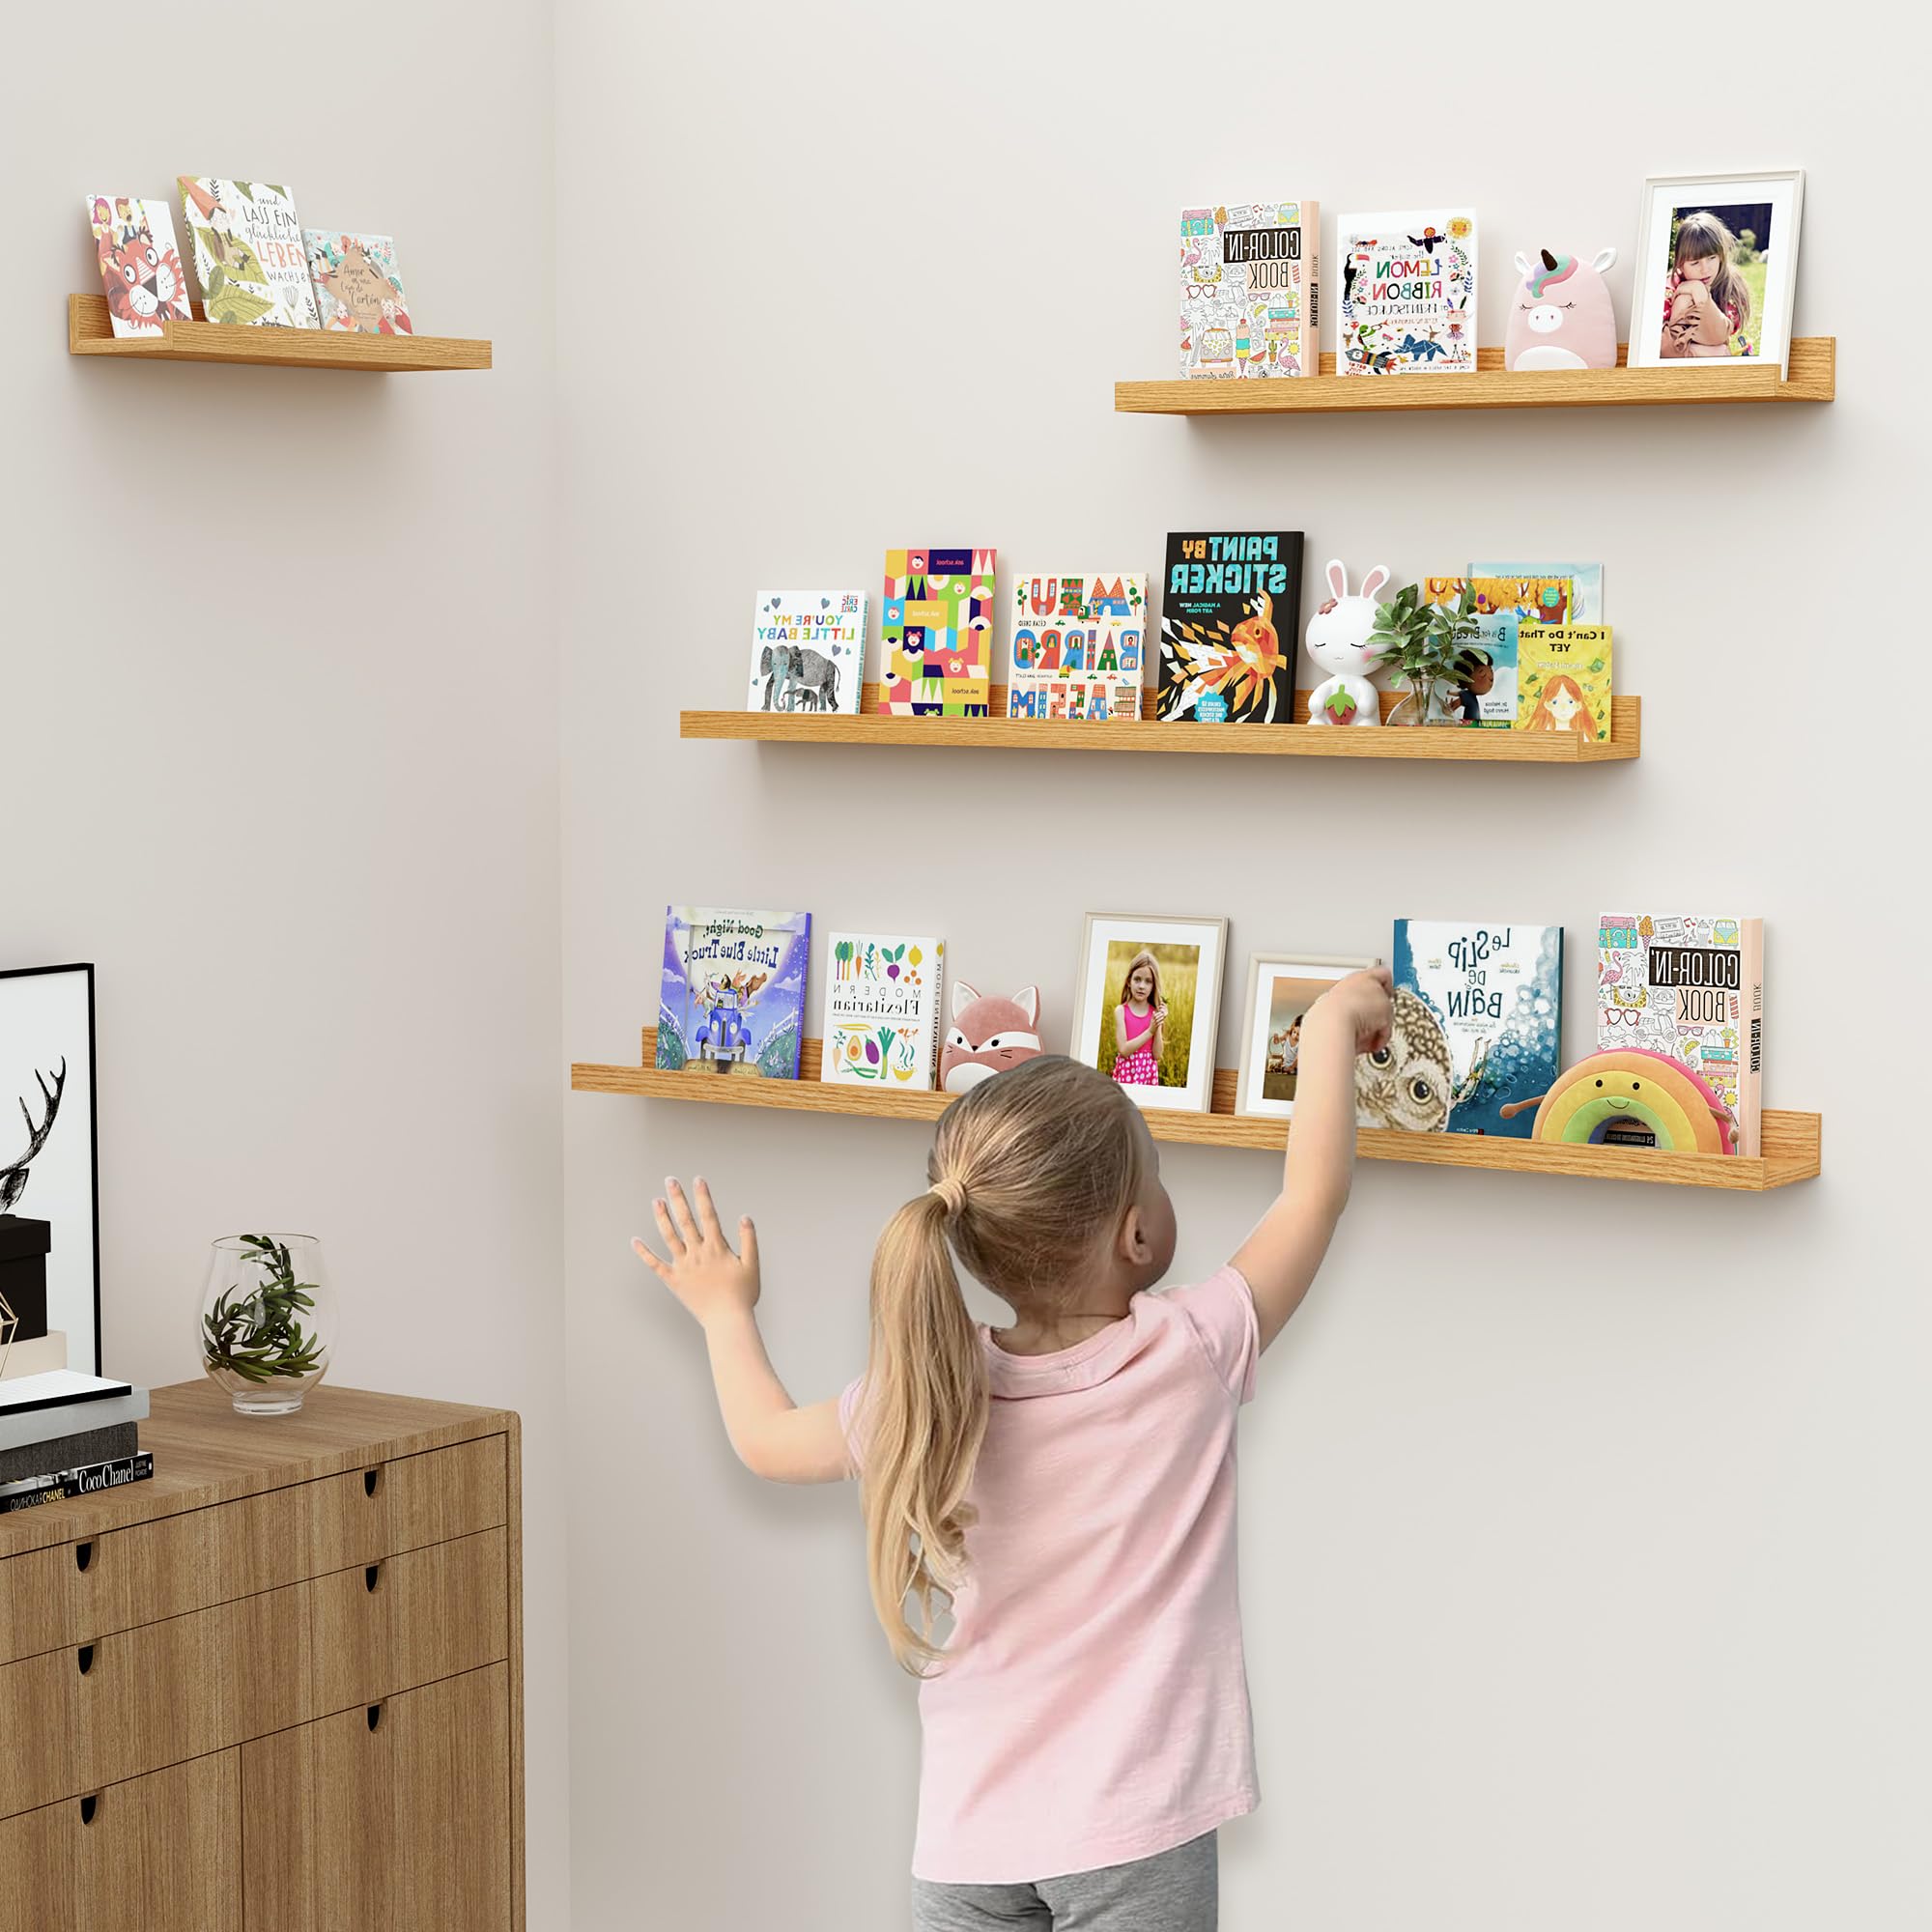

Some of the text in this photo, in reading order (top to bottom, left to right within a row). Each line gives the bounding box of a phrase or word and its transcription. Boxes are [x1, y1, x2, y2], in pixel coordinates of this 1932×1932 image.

[258, 195, 279, 205] und
[242, 206, 269, 224] LASS
[43, 1488, 66, 1504] CHANEL
